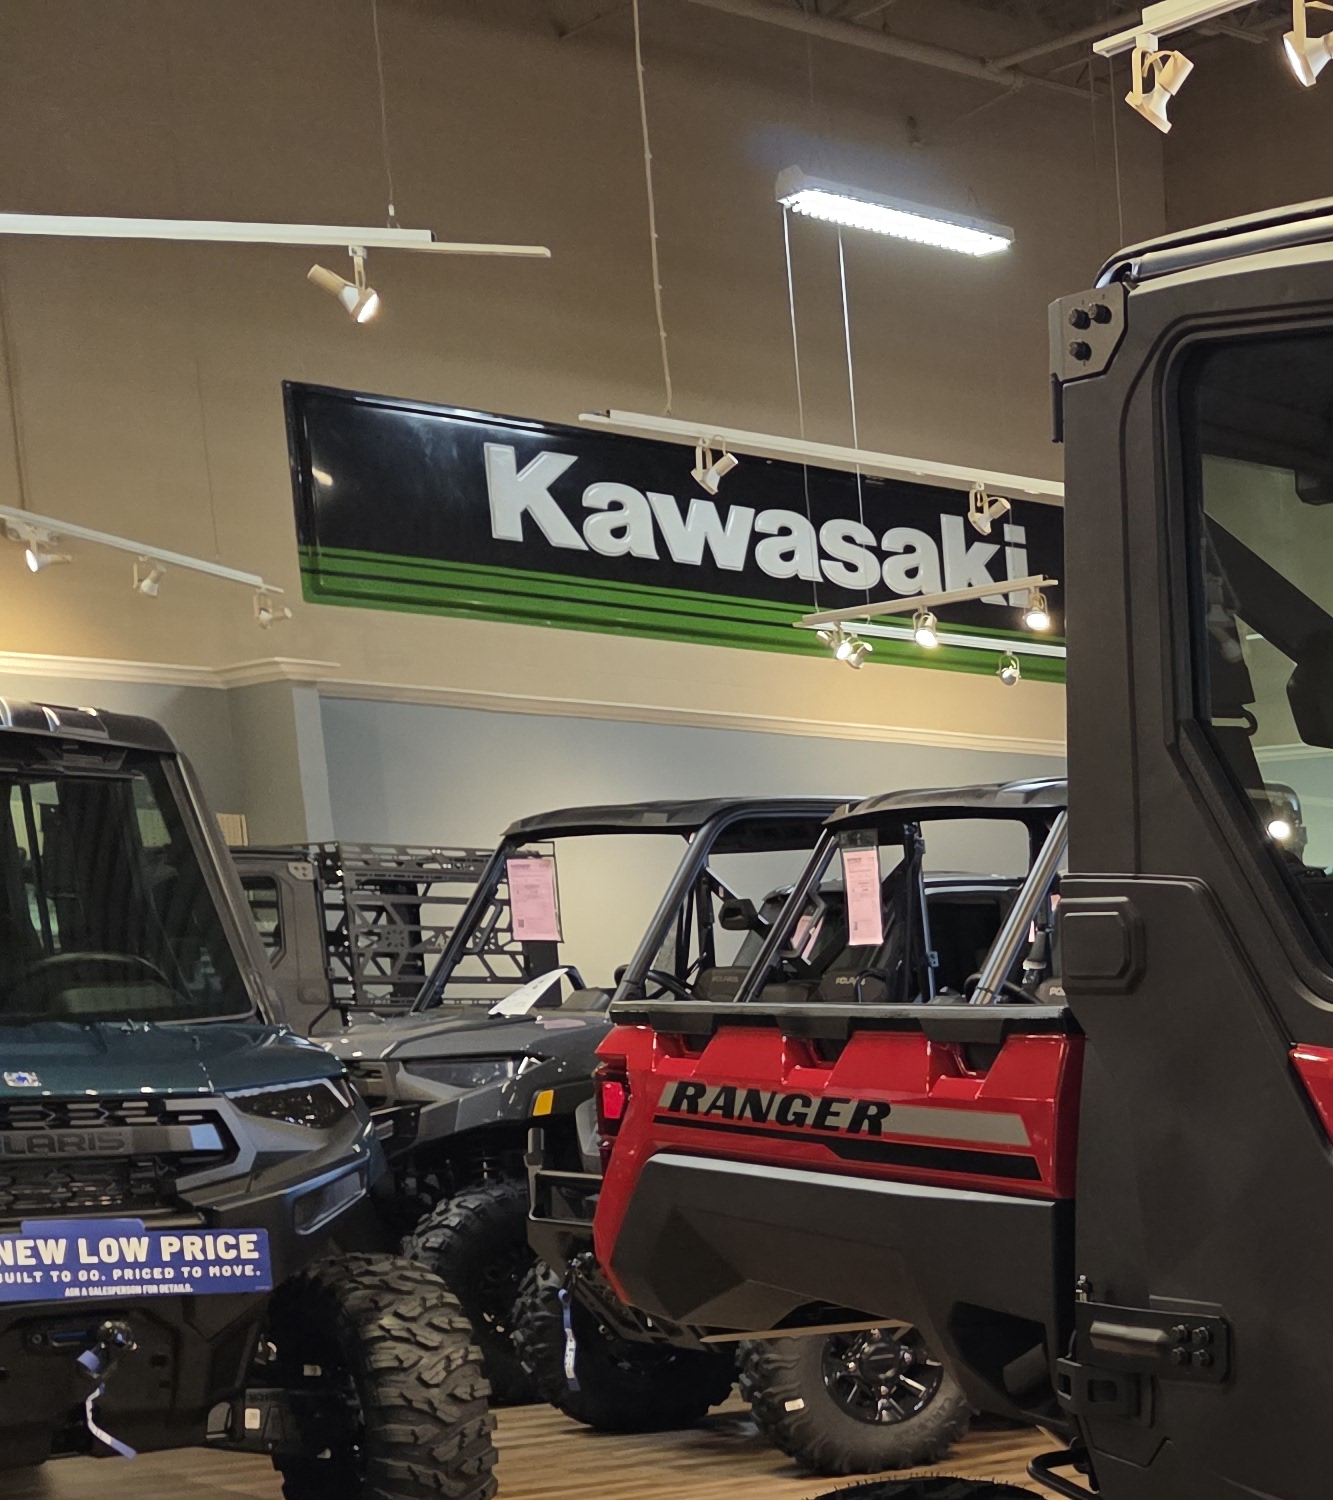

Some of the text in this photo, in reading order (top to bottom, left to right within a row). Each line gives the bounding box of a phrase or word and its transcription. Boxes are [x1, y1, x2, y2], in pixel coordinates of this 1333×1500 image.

[483, 442, 1029, 607] Kawasaki
[667, 1080, 891, 1136] RANGER
[0, 1131, 126, 1155] LARIS
[0, 1233, 260, 1266] NEW LOW PRICE
[0, 1271, 43, 1285] UILT
[50, 1270, 71, 1283] TO
[112, 1267, 175, 1281] PRICED
[180, 1266, 203, 1279] TO
[208, 1264, 261, 1278] MOVE.
